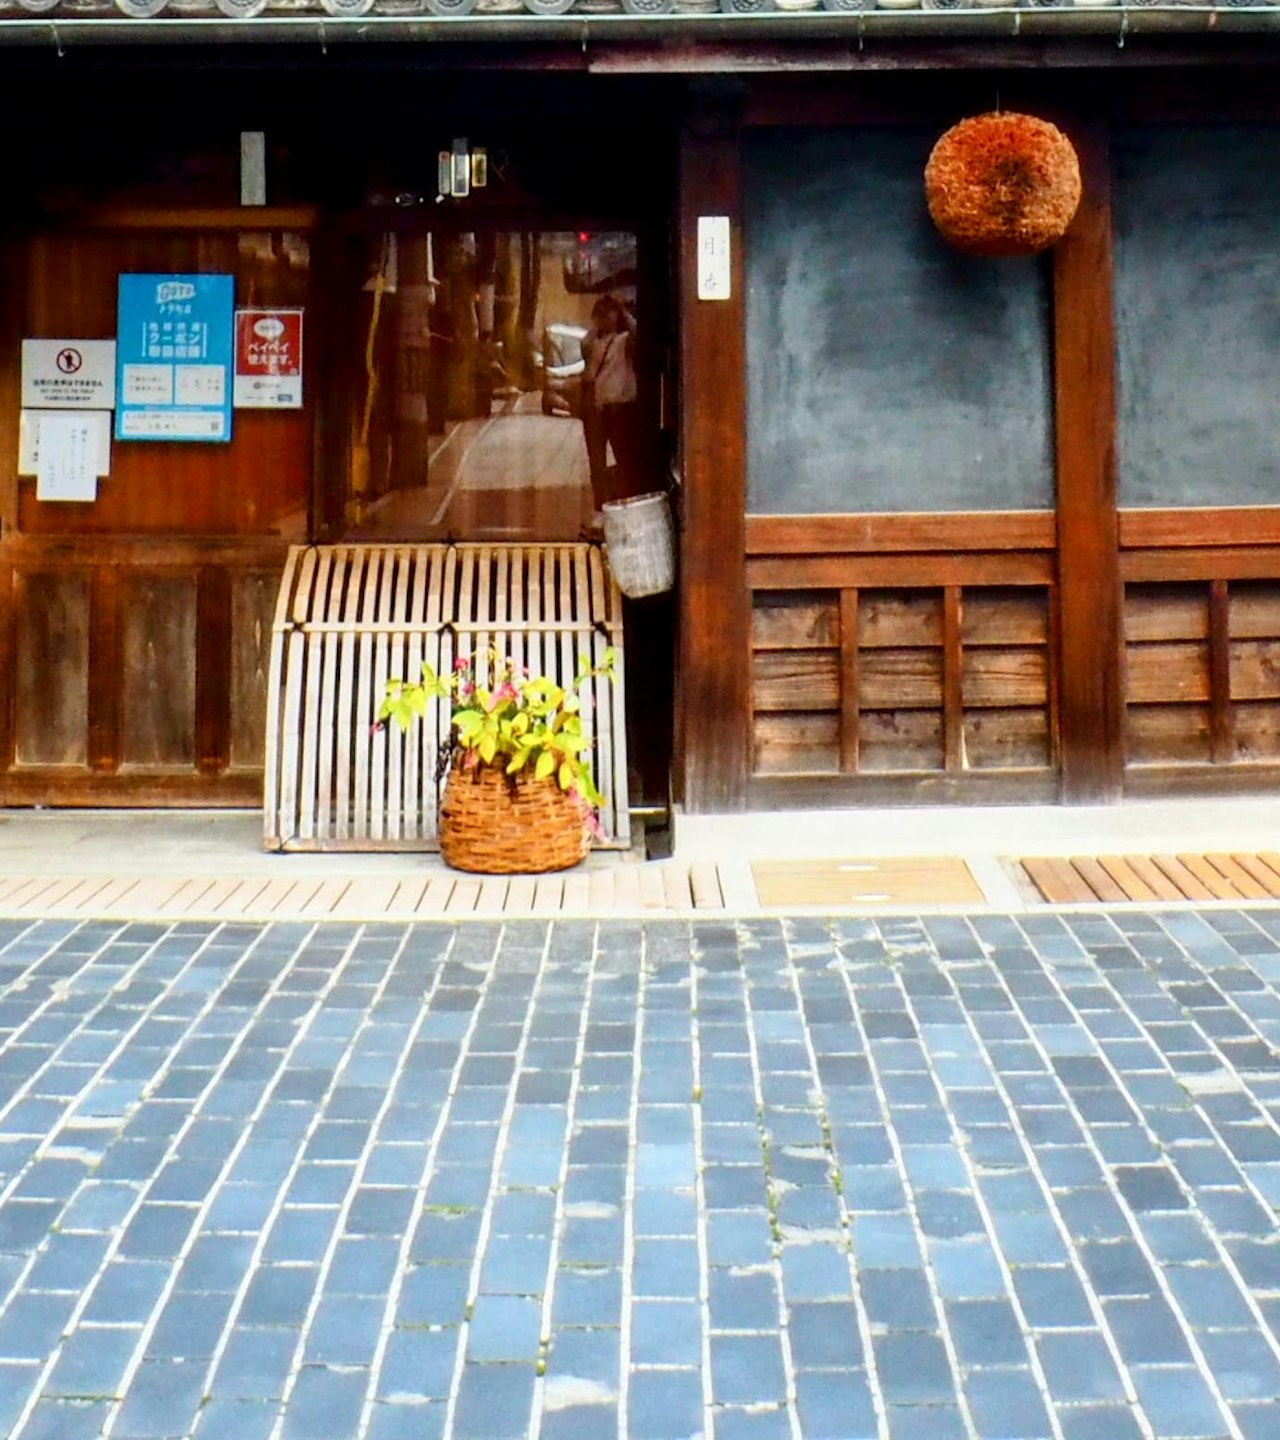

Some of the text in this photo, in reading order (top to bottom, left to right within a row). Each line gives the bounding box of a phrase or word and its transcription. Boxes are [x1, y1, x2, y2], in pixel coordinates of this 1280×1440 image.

[149, 332, 201, 345] クーポン
[247, 340, 290, 353] ペイペイ
